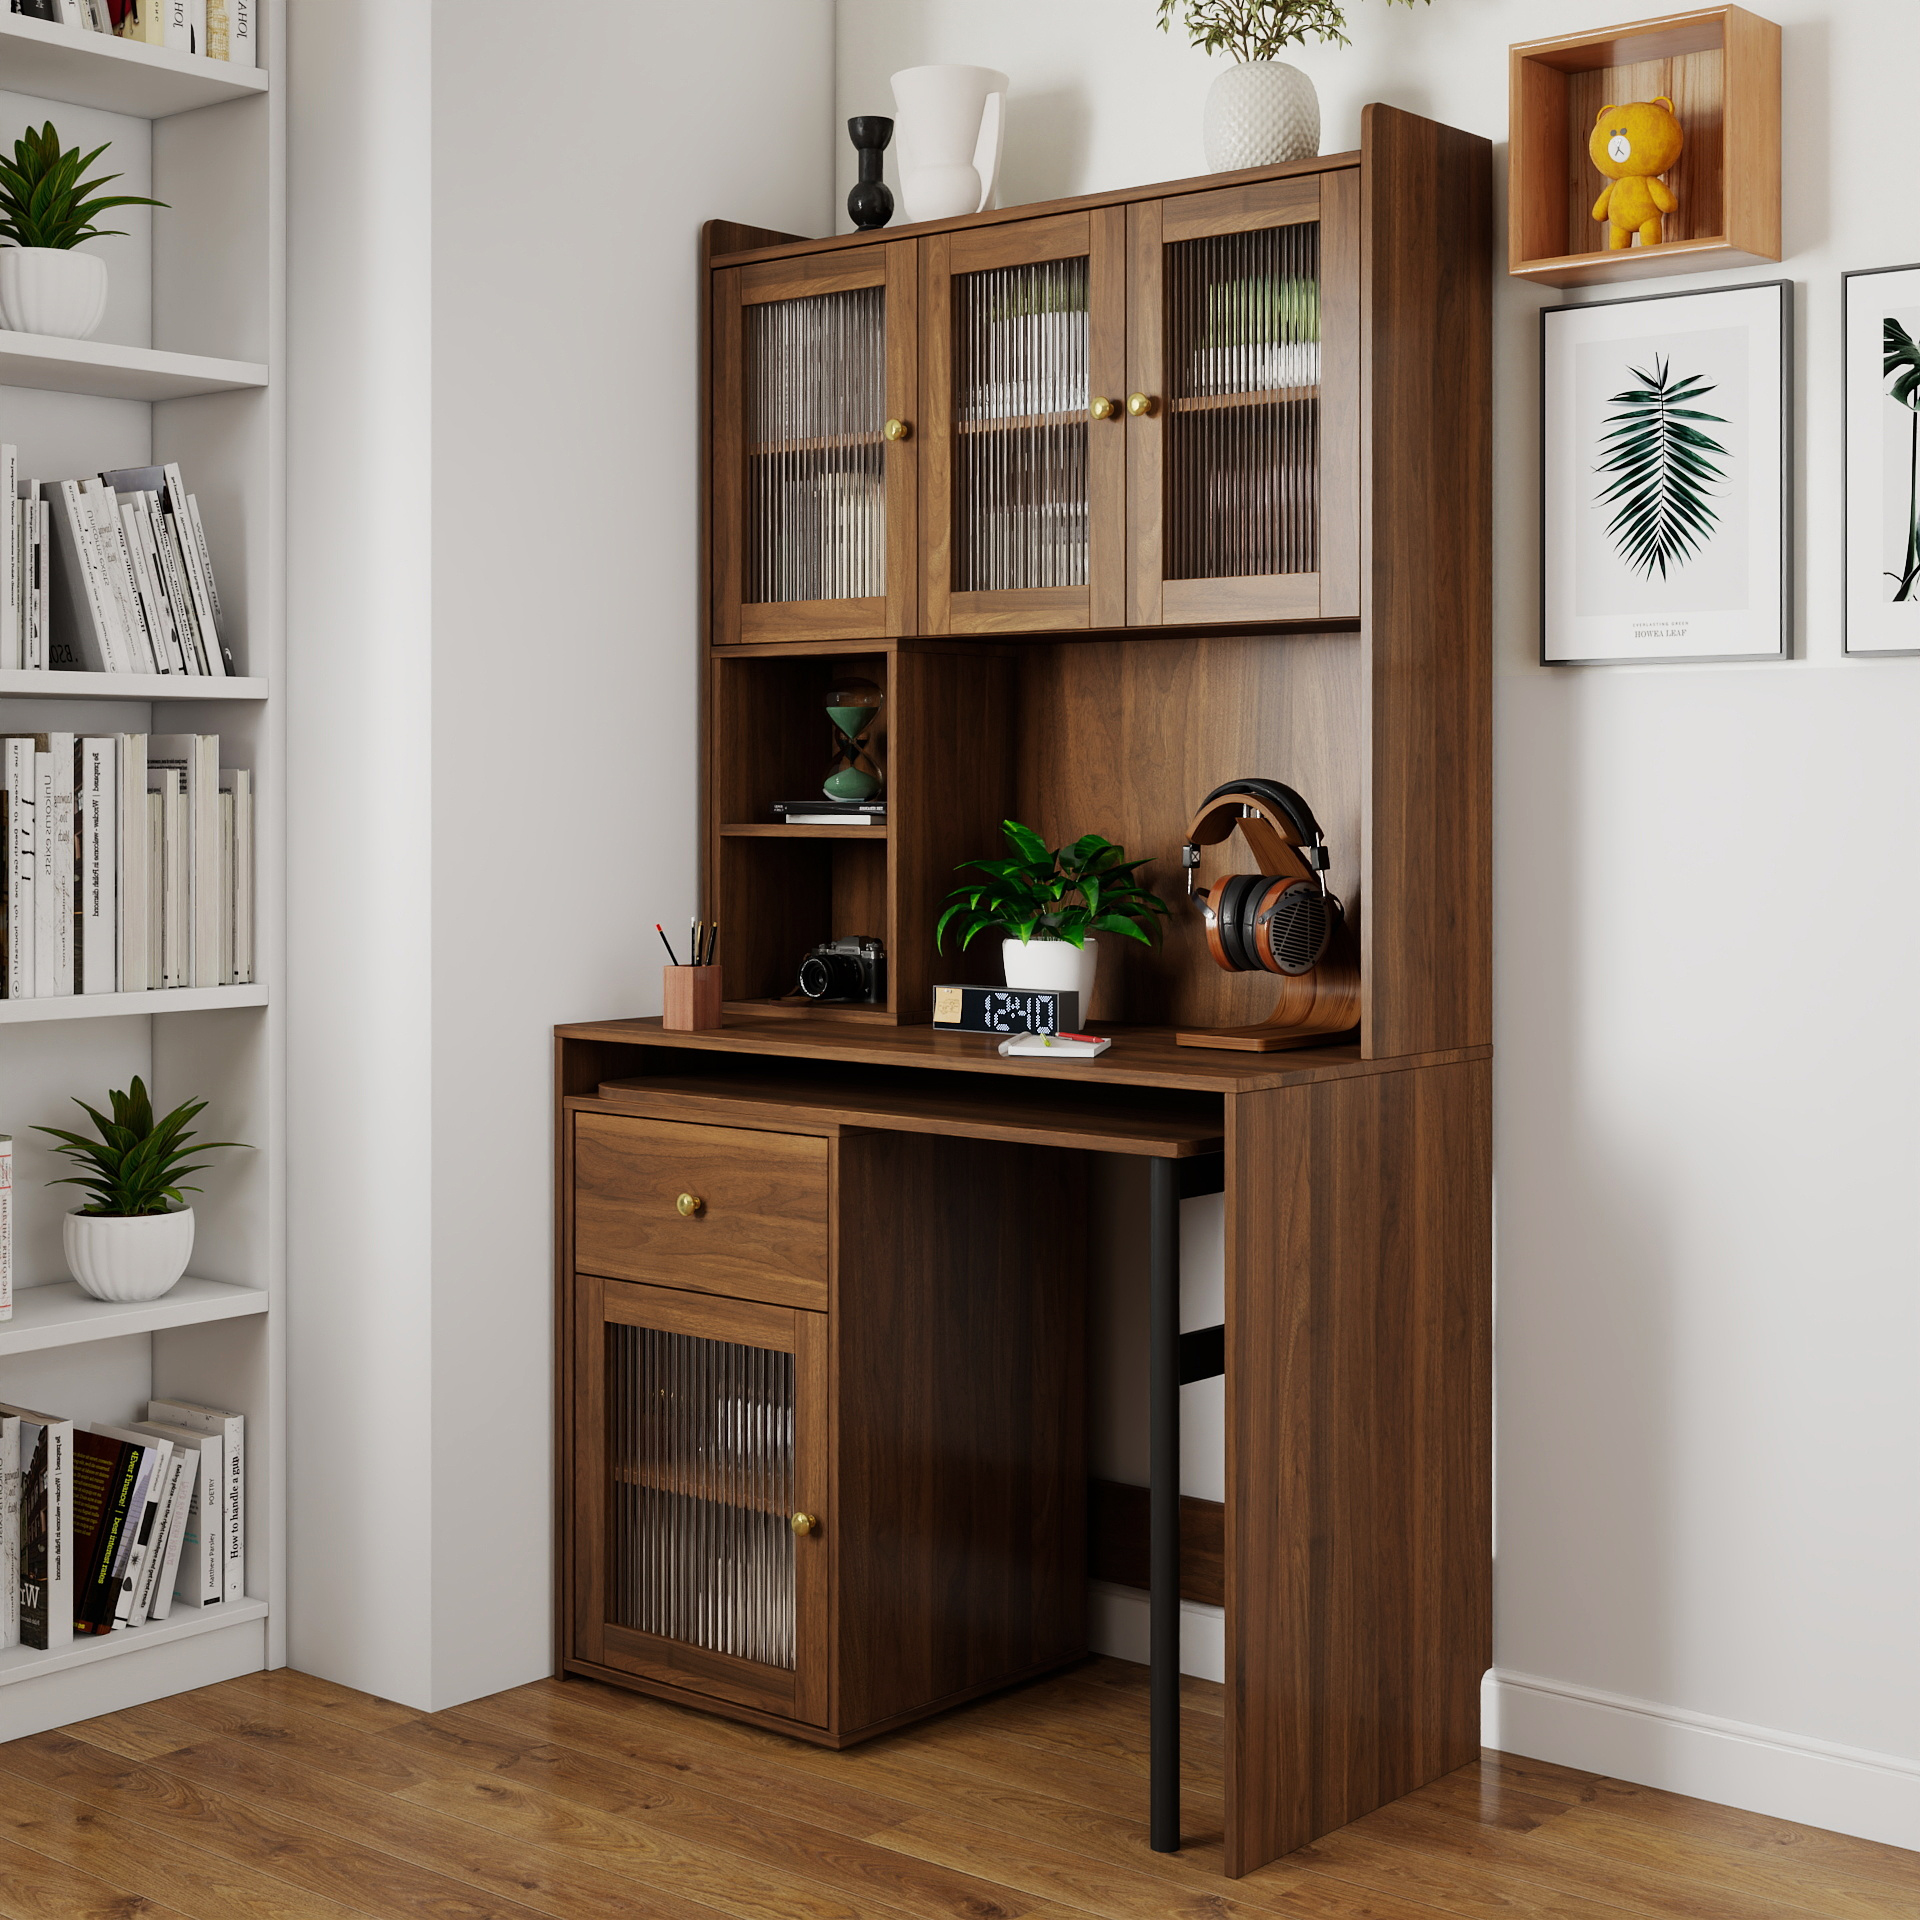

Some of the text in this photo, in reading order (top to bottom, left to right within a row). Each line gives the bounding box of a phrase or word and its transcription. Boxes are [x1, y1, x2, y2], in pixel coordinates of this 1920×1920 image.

[1634, 629, 1687, 638] HOWEA LEAF
[985, 992, 1054, 1034] 12:40
[173, 1464, 183, 1483] Baking
[231, 1456, 240, 1475] gun
[230, 1486, 239, 1521] handle
[97, 1450, 140, 1585] 4Ever Finance! best interest rates
[160, 1518, 168, 1532] right
[230, 1523, 239, 1533] to
[230, 1536, 239, 1559] How
[140, 1590, 149, 1608] results
